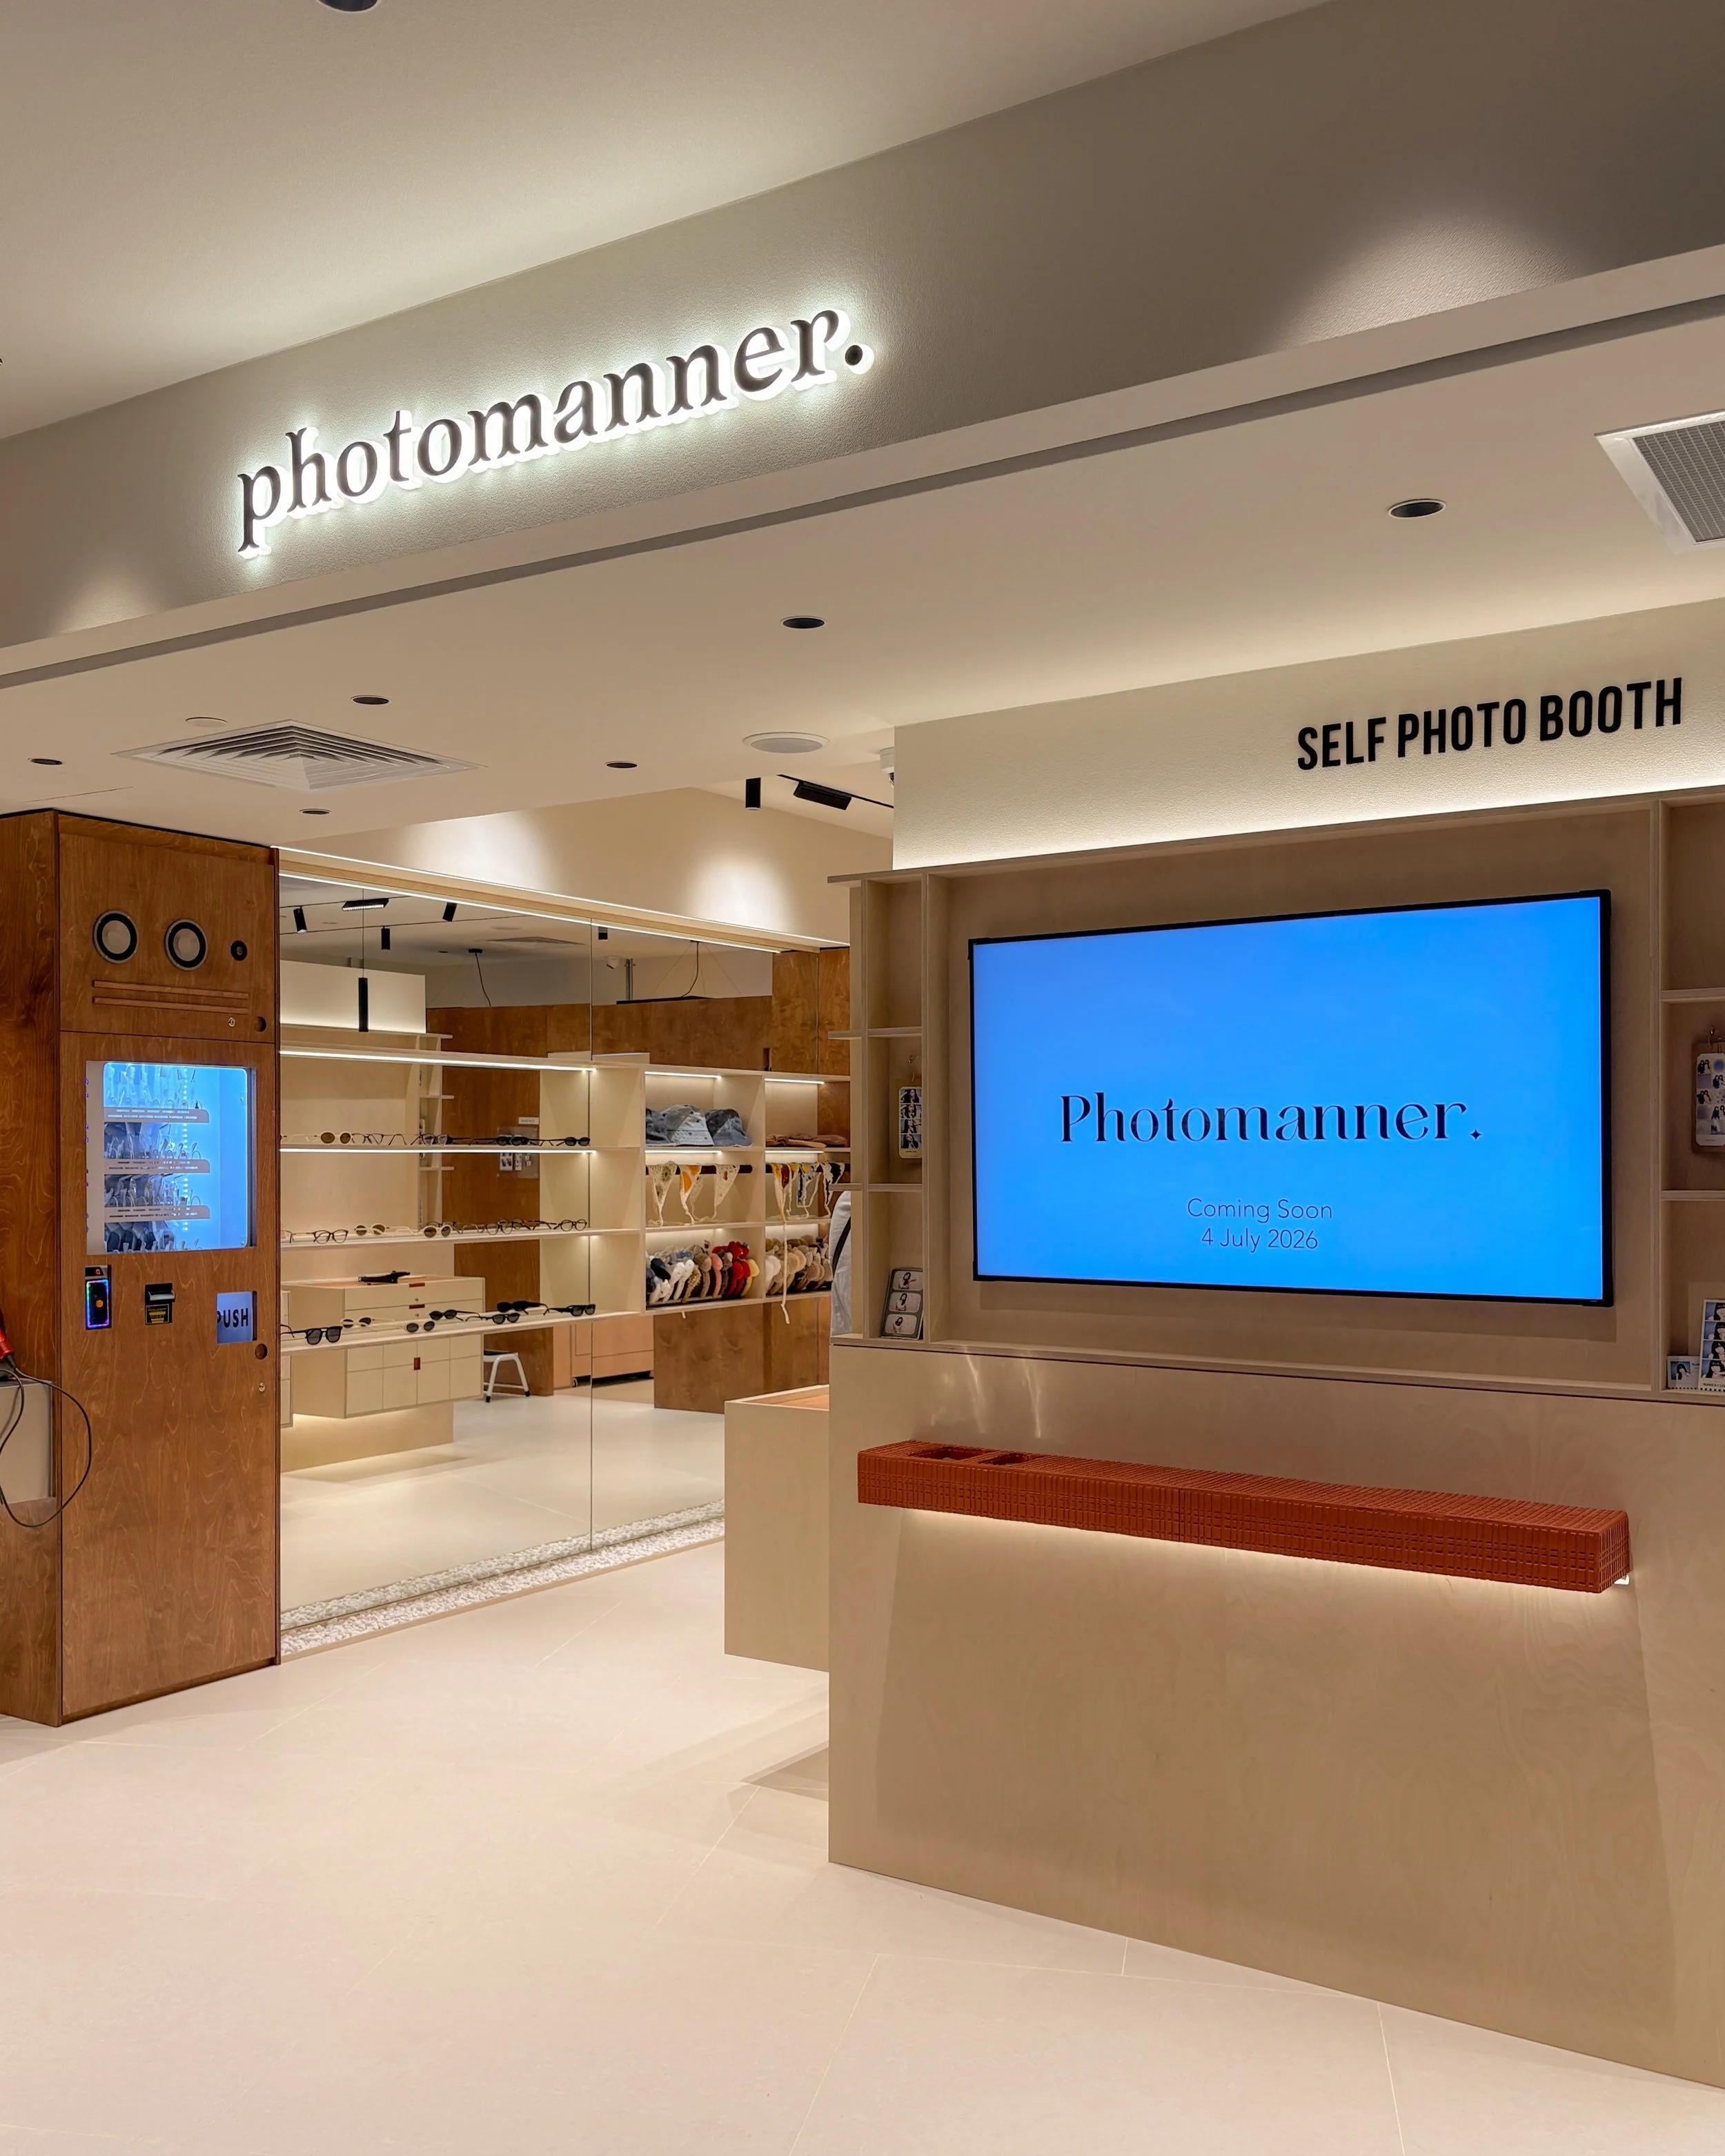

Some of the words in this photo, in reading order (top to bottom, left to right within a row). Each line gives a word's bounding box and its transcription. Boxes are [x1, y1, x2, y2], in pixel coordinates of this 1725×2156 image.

[236, 308, 864, 553] photomanner.
[1297, 716, 1387, 771] SELF
[1397, 698, 1526, 758] PHOTO
[1539, 677, 1682, 742] BOOTH
[1061, 1092, 1481, 1142] Photomanner.
[1187, 1198, 1270, 1223] Coming
[1278, 1198, 1332, 1219] Soon
[1201, 1227, 1214, 1246] 4
[1219, 1227, 1261, 1253] July
[1268, 1229, 1318, 1249] 2026
